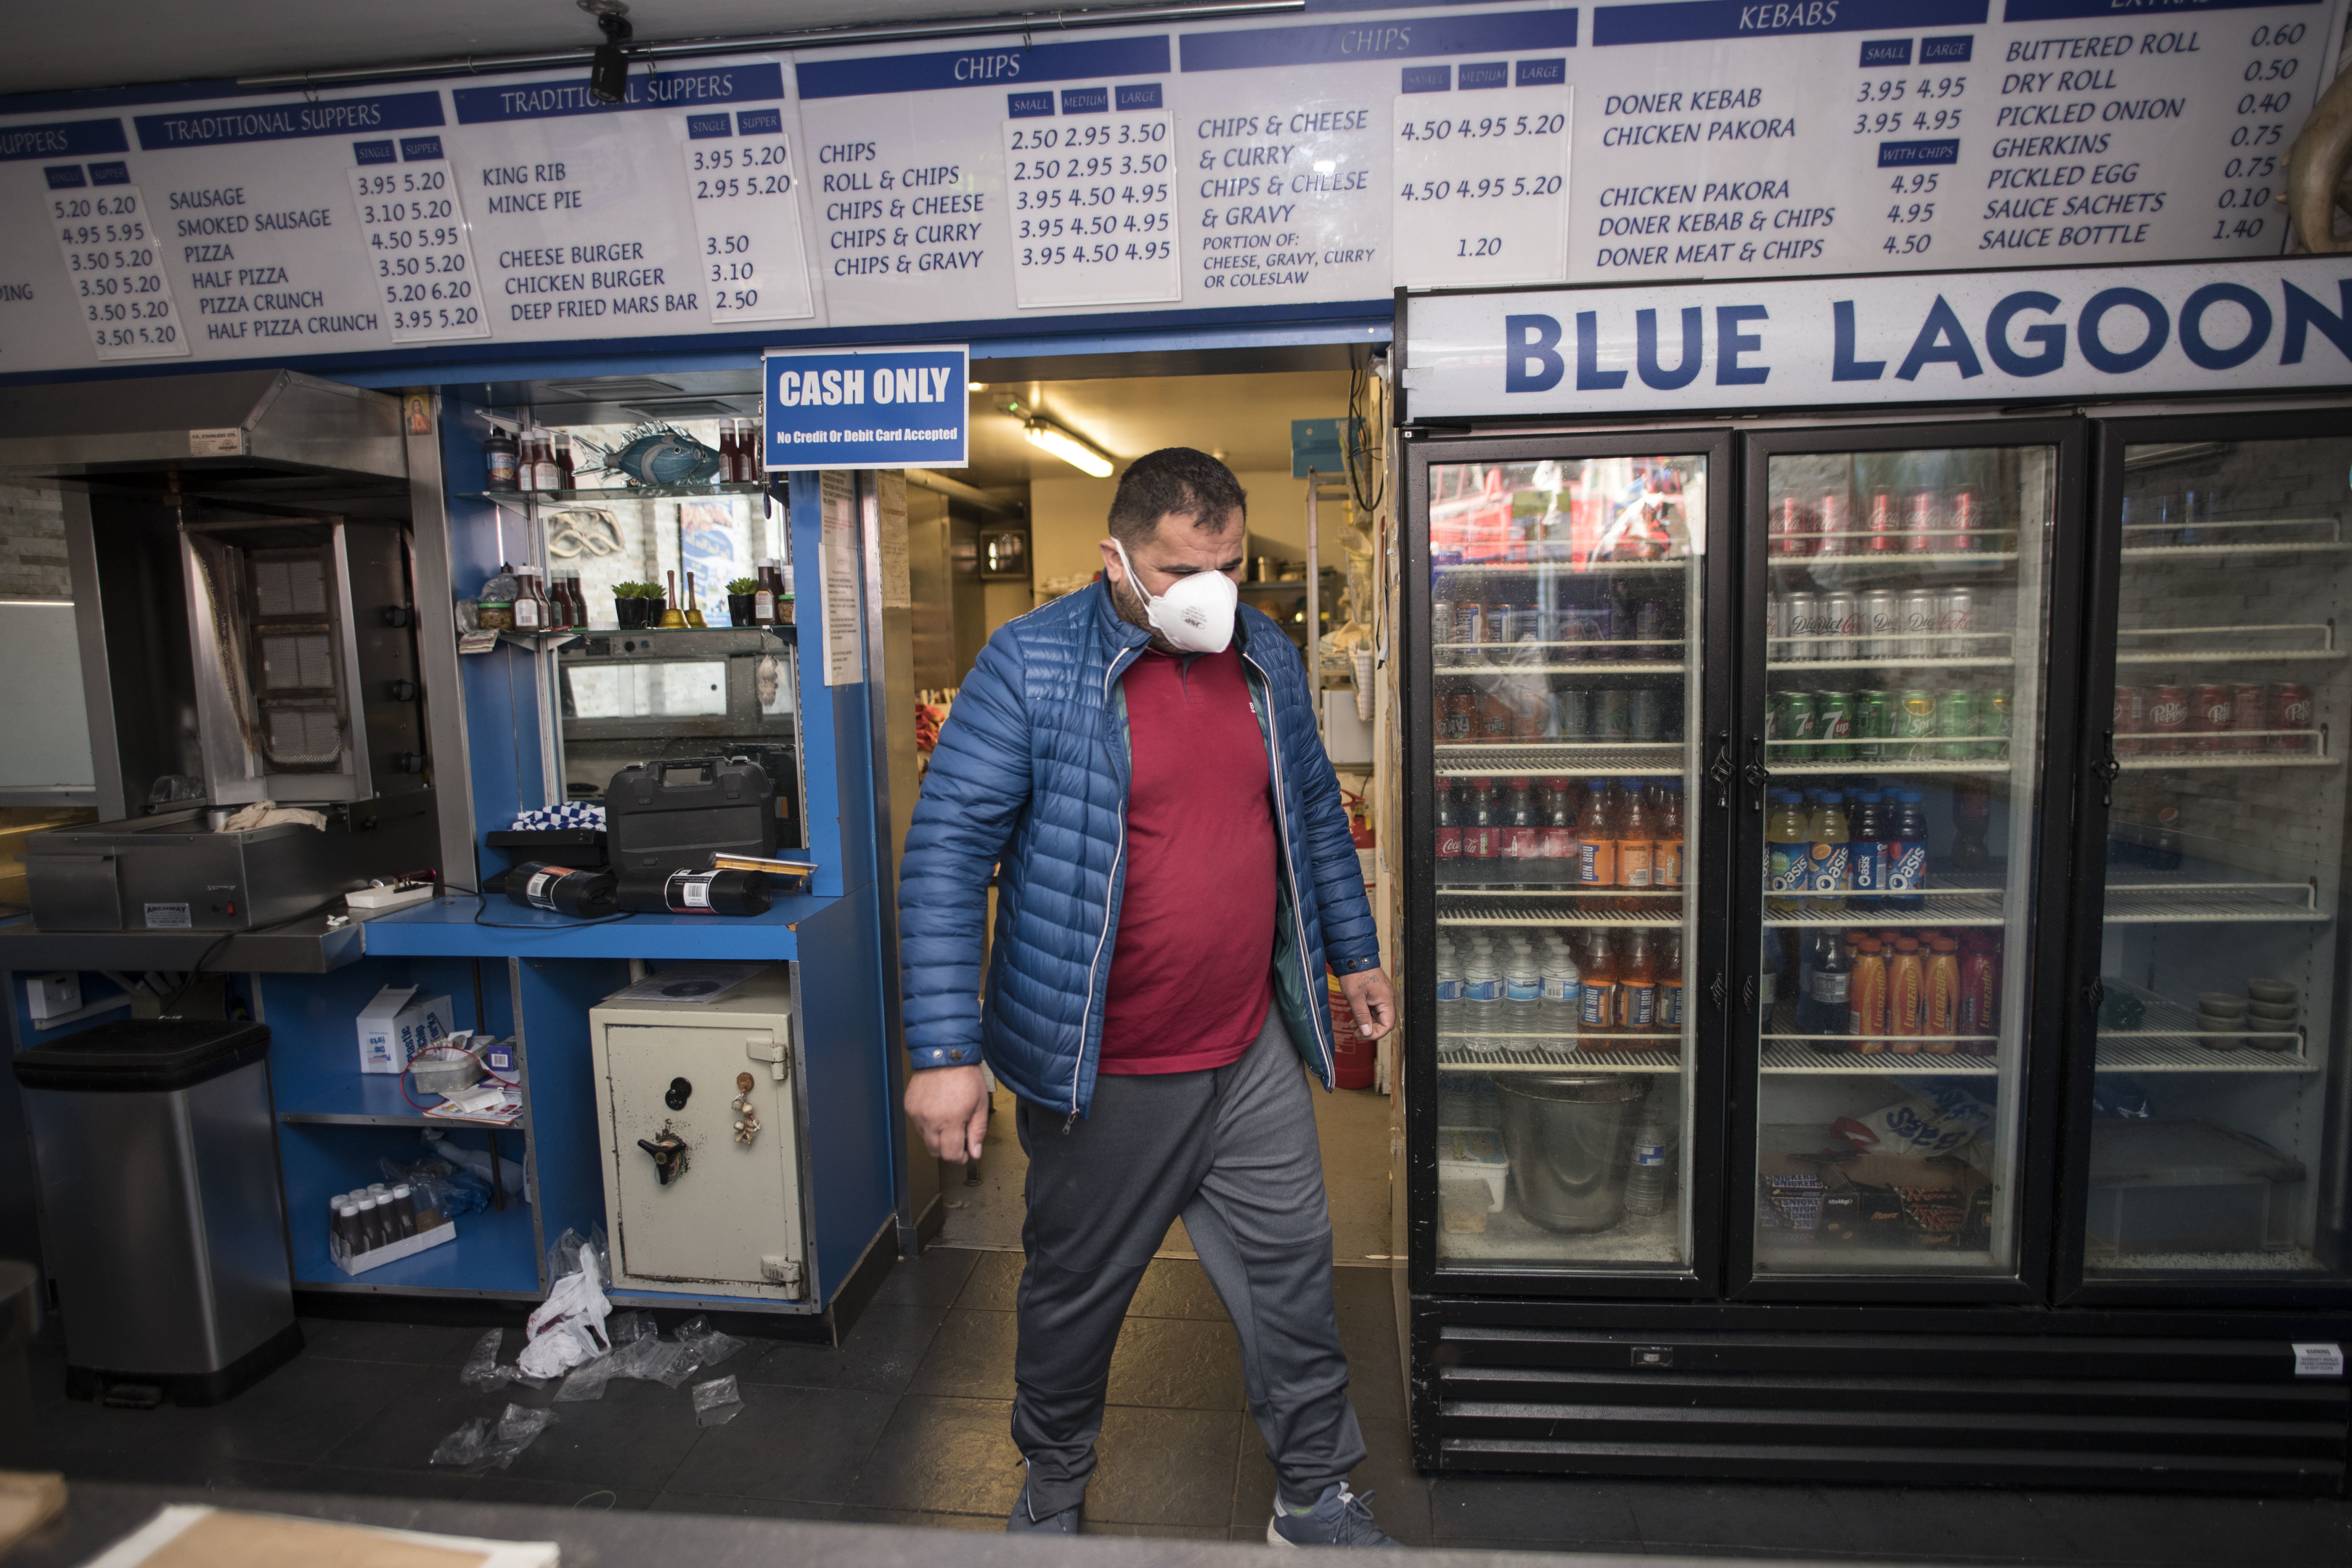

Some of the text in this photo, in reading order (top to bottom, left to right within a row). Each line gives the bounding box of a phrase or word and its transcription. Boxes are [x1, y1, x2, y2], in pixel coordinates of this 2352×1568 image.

[1739, 1, 1838, 29] KEBABS
[1341, 28, 1410, 54] CHIPS
[2006, 32, 2200, 62] BUTTERED ROLL
[2252, 23, 2306, 46] 0.60
[1866, 44, 1964, 60] SMALL LARGE
[955, 54, 1019, 80] CHIPS
[501, 75, 733, 114] TRADITIAL SUPPERS
[1015, 91, 1154, 111] SMALL MEDIUM LARGE
[1605, 89, 1762, 115] DONER KEBAB
[1858, 77, 1966, 102] 3.95 4.95
[163, 103, 382, 142] TRADITIONAL SUPPERS
[1198, 110, 1368, 139] CHIPS & CHEESE
[1997, 98, 2186, 126] PICKLED ONION
[1012, 123, 1165, 150] 2.50 2.95 3.50
[1402, 114, 1564, 140] 4.50 4.95 5.20
[1604, 118, 1794, 147] CHICKEN PAKORA
[0, 130, 68, 154] UPPERS
[820, 142, 875, 163] CHIPS
[1884, 147, 1953, 160] WITH CHIPS
[1993, 133, 2111, 158] GHERKINS
[695, 146, 785, 170] 3.95 5.20
[1200, 146, 1294, 170] & CURRY
[359, 171, 444, 195] 3.95 5.20
[483, 163, 565, 186] KING RIB
[824, 166, 958, 192] ROLL & CHIPS
[55, 196, 135, 219] 5.20 6.20
[170, 188, 245, 210] SAUSAGE
[489, 191, 581, 213] MINCE PIE
[827, 194, 984, 221] CHIPS & CHEESE
[1984, 192, 2166, 219] SAUCE SACHETS
[178, 210, 331, 237] SMOKED SAUSAGE
[831, 223, 981, 249] CHIPS & CURRY
[2213, 218, 2264, 239] 1.40
[707, 235, 749, 255] 3.50
[1203, 234, 1299, 250] PORTION OF:
[1458, 237, 1501, 256] 1.20
[1883, 234, 1931, 253] 4.50
[1980, 224, 2149, 249] SAUCE BOTTLE
[184, 245, 234, 263] PIZZA
[499, 242, 643, 269] CHEESE BURGER
[1204, 249, 1375, 269] CHEESE, GRAVY, CURRY
[1597, 240, 1824, 266] DONER MEAT & CHIPS
[192, 267, 288, 288] HALF PIZZA
[505, 269, 664, 295] CHICKEN BURGER
[1204, 271, 1308, 288] OR COLESLAW
[200, 291, 323, 314] PIZZA CRUNCH
[511, 293, 698, 321] DEEP FRIED MARS BAR
[208, 314, 377, 339] HALF PIZZA CRUNCH
[1506, 277, 2352, 393] BLUE LAGOON
[780, 368, 950, 407] CASH ONLY
[777, 428, 957, 444] No Credit Or Debit Card Accepted
[1903, 970, 1917, 1029] Lucozade
[1932, 971, 1946, 1029] Lucozade
[1979, 969, 1993, 1029] Lucozade
